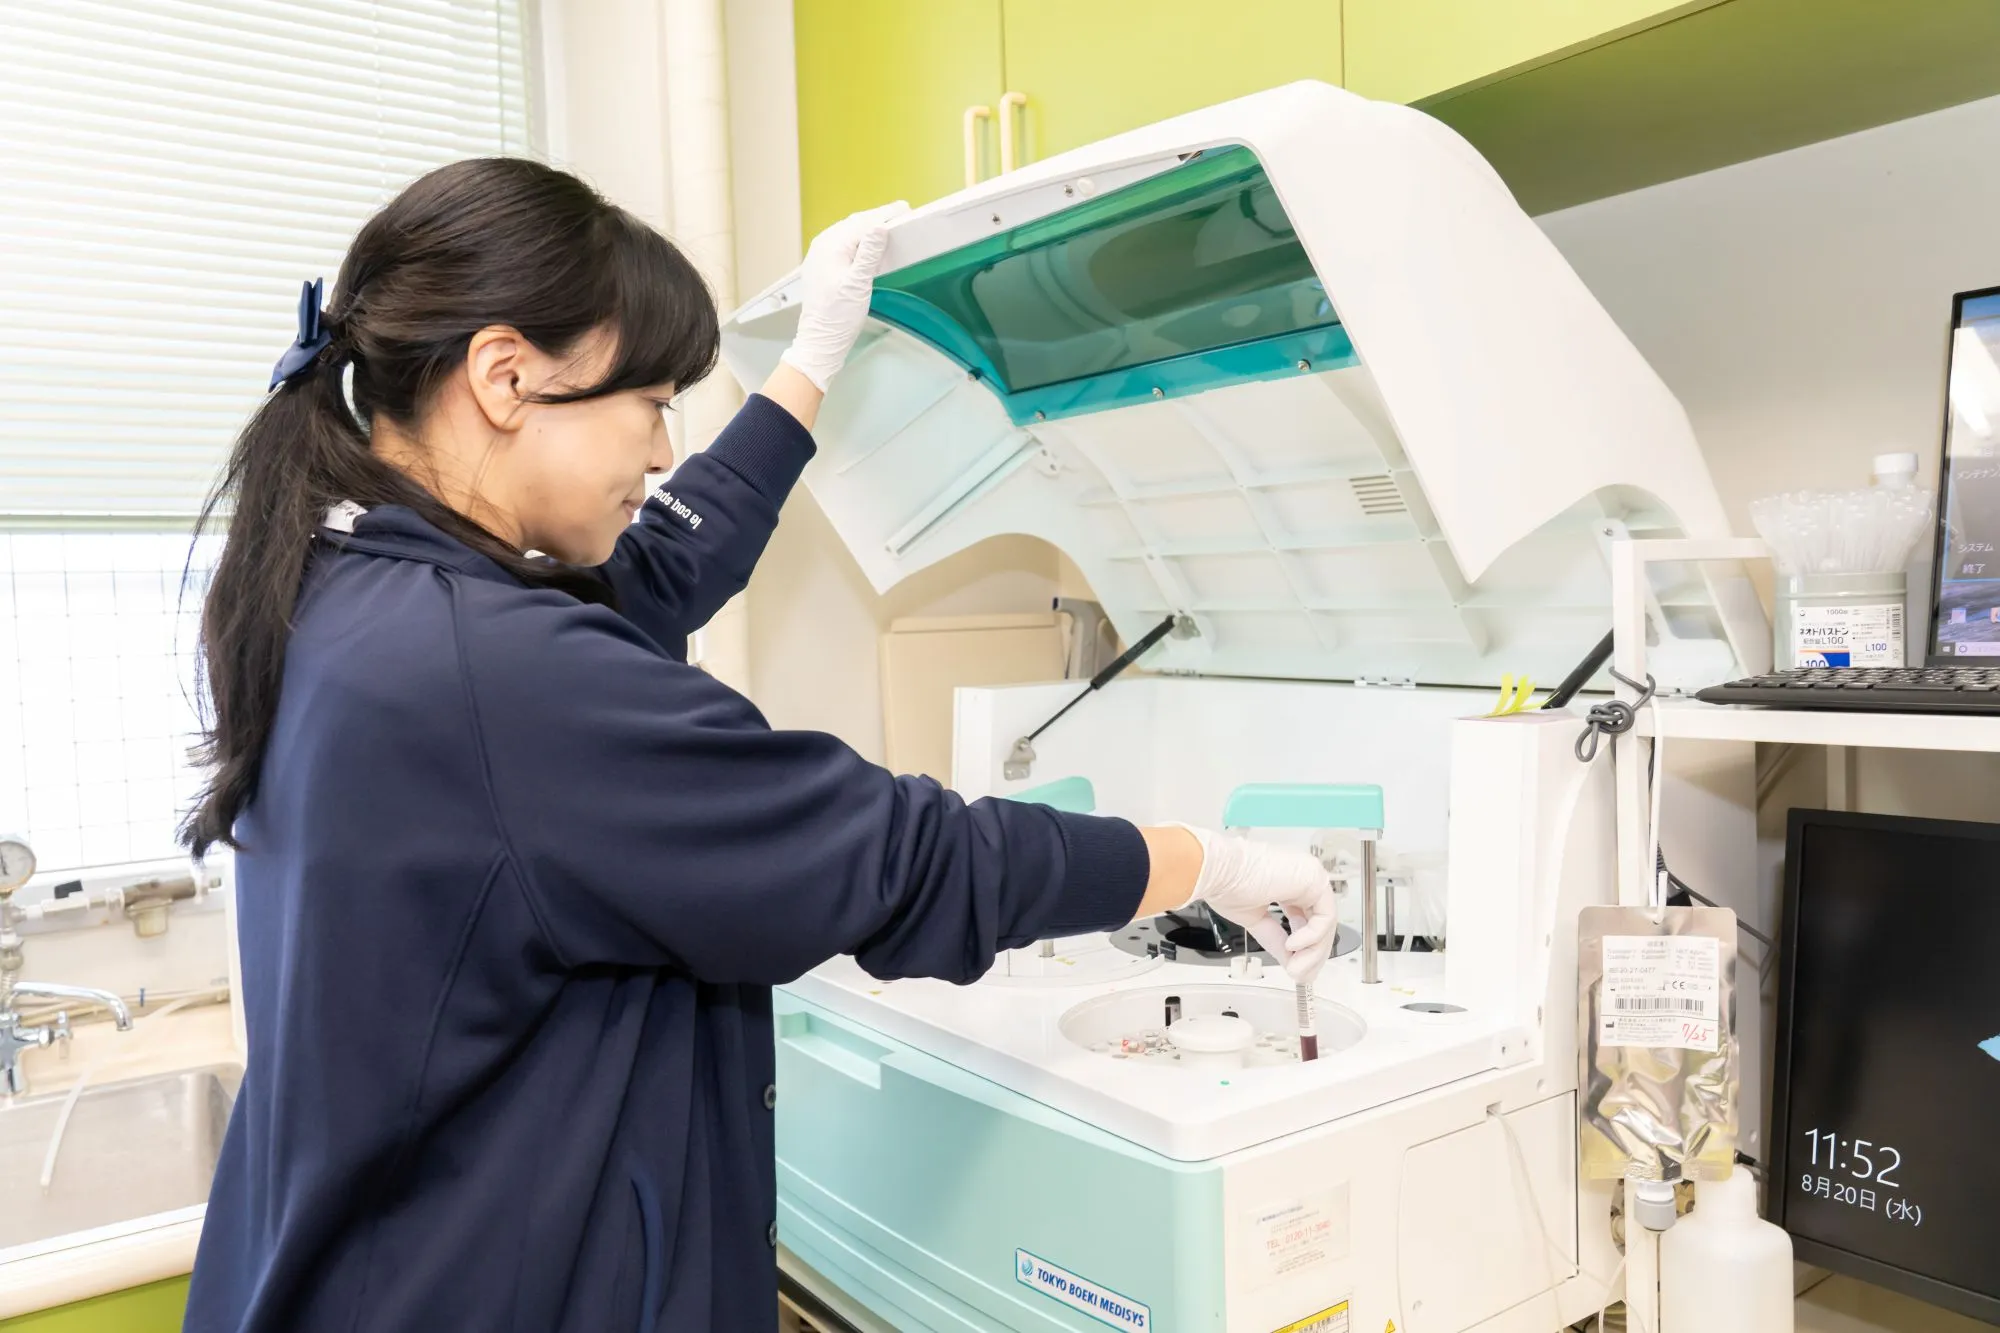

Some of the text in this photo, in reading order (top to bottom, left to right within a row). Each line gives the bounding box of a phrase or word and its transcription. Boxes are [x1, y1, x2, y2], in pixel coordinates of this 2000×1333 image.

[653, 487, 703, 530] le coq spo
[1958, 542, 1994, 554] システム
[1962, 563, 1987, 574] 終了
[1865, 642, 1887, 652] L100
[1804, 1128, 1901, 1188] 11:52
[1801, 1174, 1922, 1227] 8月20日 (水)
[1037, 1267, 1145, 1327] TOKYO BOEKI MEDISYS
